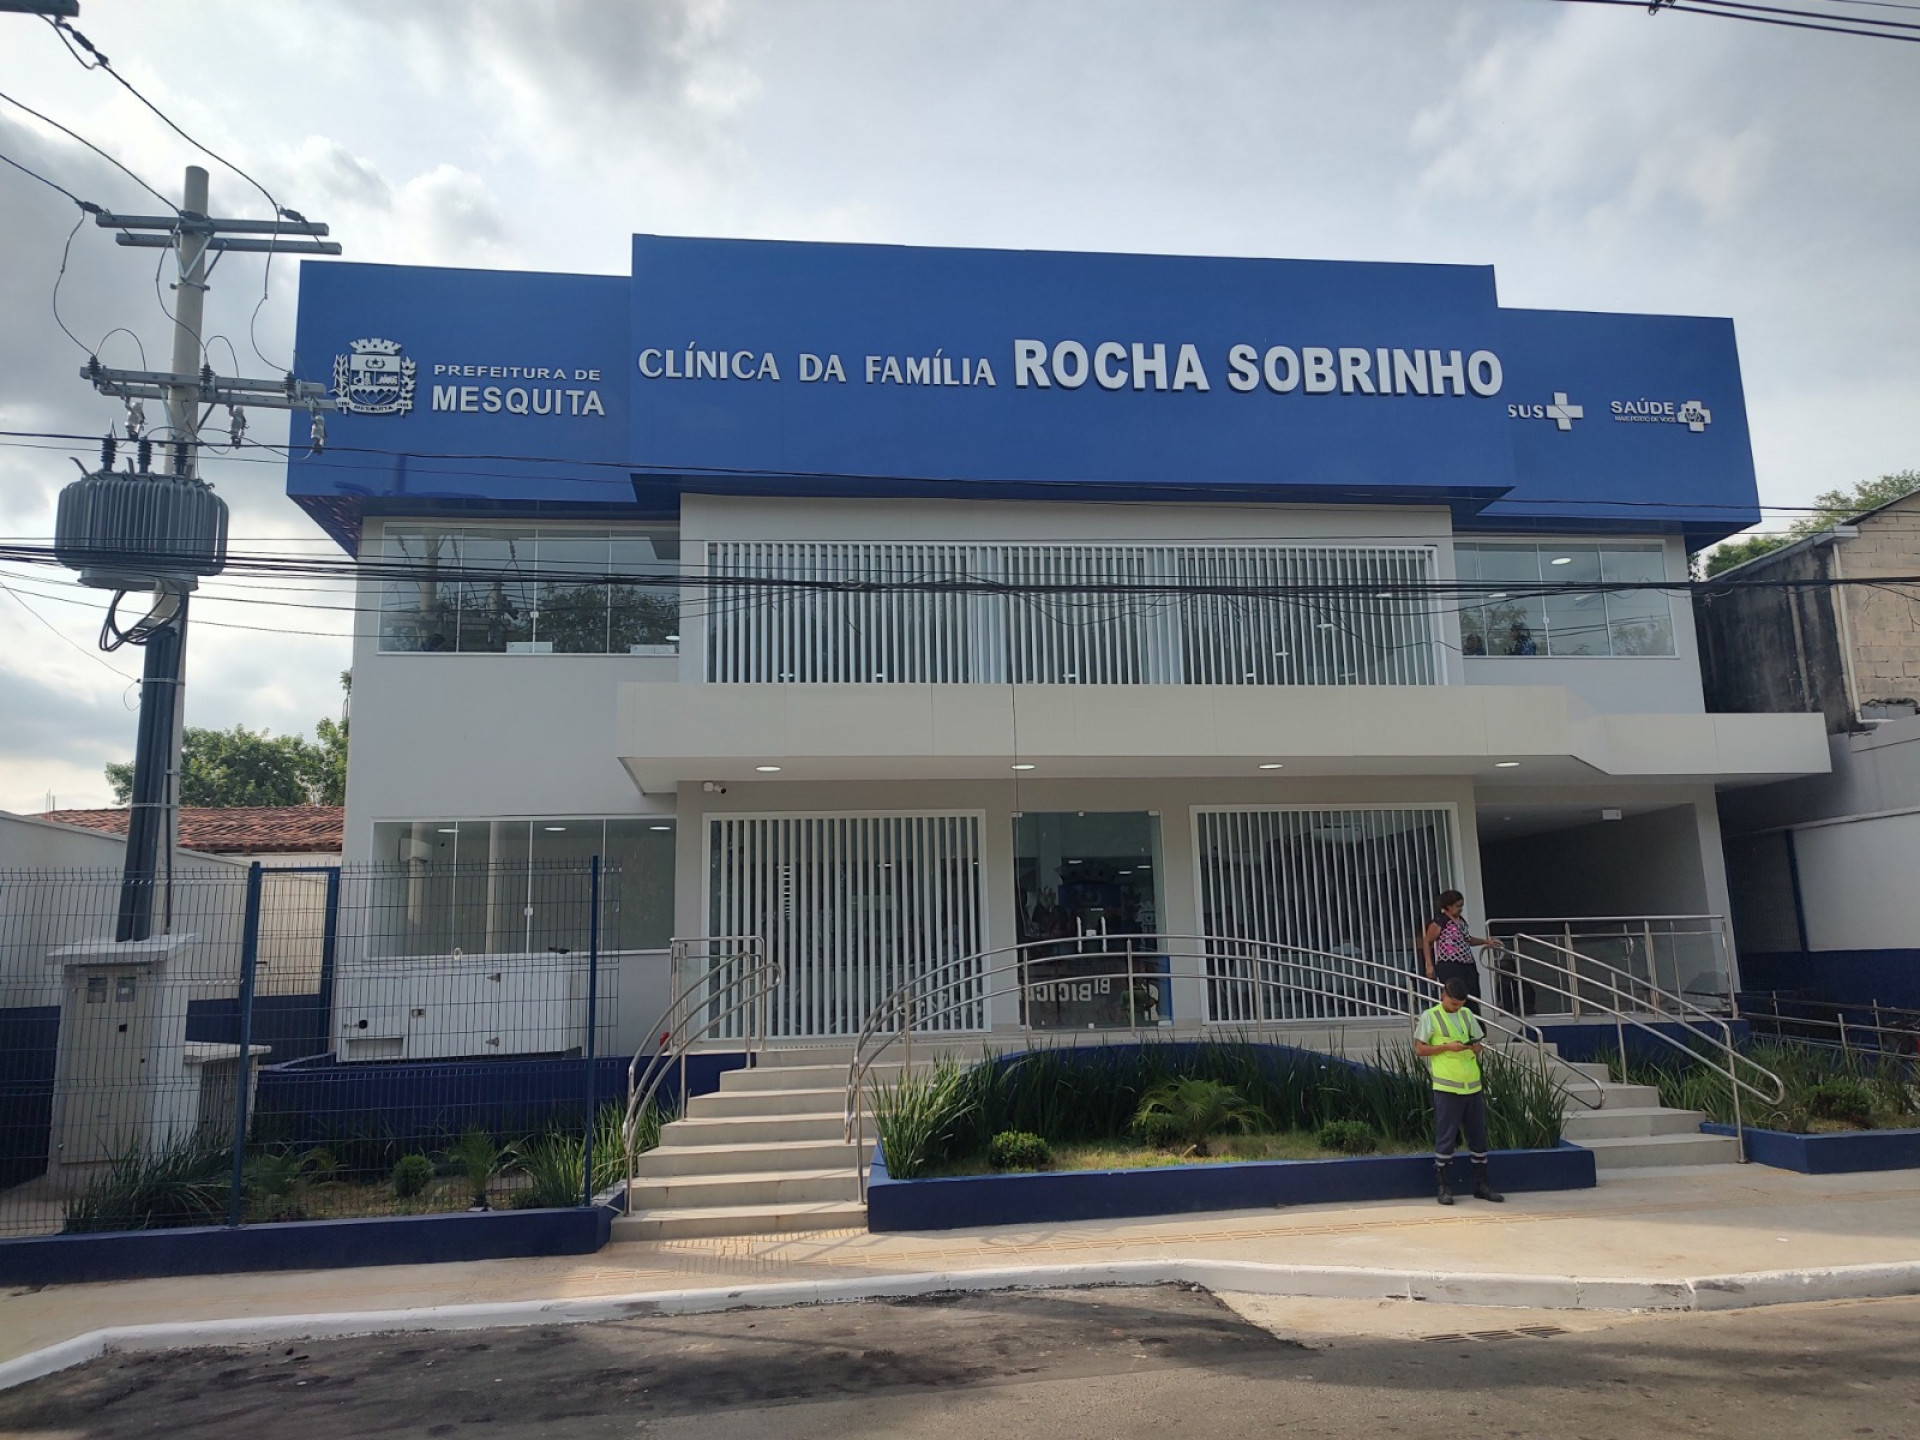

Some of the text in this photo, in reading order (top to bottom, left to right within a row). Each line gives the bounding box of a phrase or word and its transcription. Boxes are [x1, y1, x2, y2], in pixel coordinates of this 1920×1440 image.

[434, 364, 601, 381] PREFEITURA DE
[638, 339, 1504, 396] CLÍNICA DA FAMÍLIA ROCHA SOBRINHO
[432, 385, 605, 416] MESQUITA
[1611, 397, 1675, 415] SAÚDE
[1508, 404, 1544, 418] SUS
